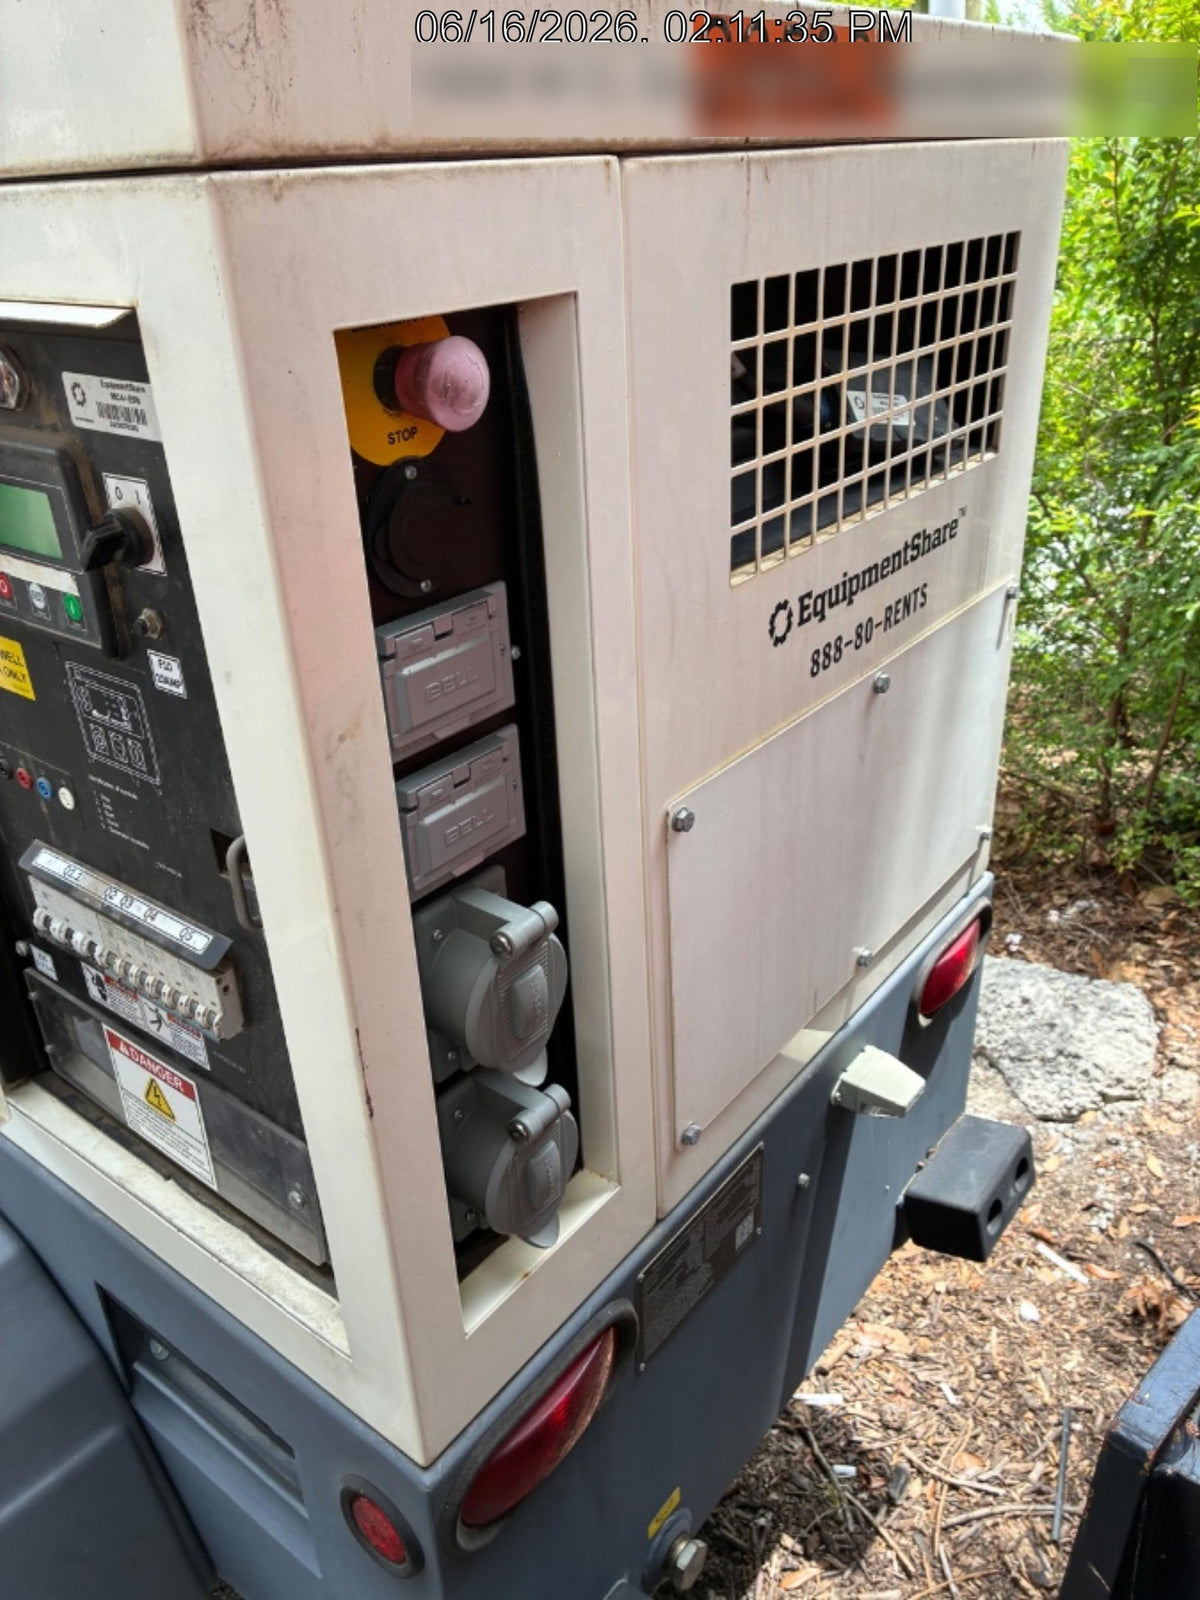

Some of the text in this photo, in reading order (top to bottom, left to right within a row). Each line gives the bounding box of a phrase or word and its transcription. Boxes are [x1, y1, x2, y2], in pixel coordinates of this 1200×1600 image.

[387, 426, 418, 446] STOP
[797, 518, 960, 628] EquipmentShare
[810, 582, 929, 678] 888-80-RENTS
[426, 665, 480, 702] BELL
[445, 808, 496, 847] BELL
[128, 1045, 184, 1093] DANGER
